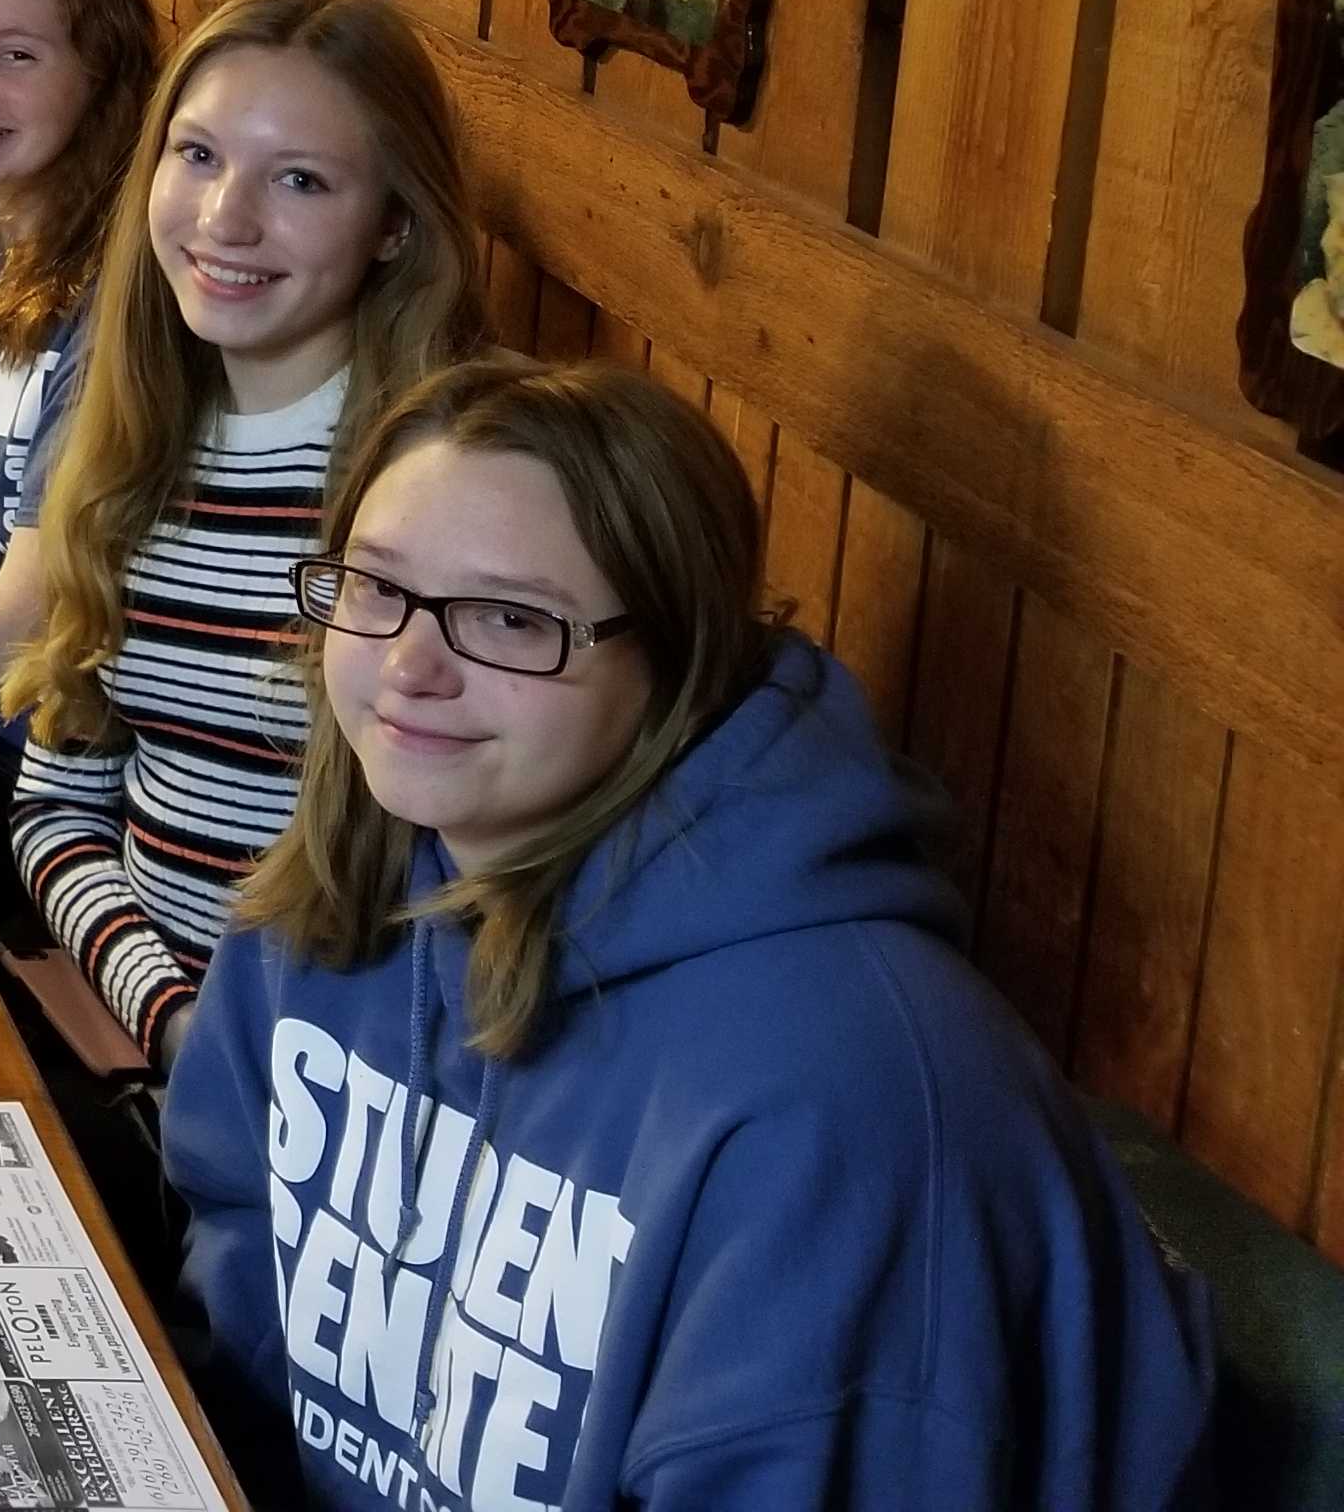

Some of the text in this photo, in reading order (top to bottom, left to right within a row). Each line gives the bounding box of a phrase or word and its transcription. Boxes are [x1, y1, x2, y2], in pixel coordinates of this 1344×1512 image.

[57, 1277, 85, 1316] Services
[74, 1317, 90, 1332] Tool
[75, 1273, 131, 1374] www.pelotoninc.com
[270, 1174, 564, 1512] ENTE
[84, 1335, 109, 1368] Machine
[37, 1384, 100, 1501] EXCELLENT
[64, 1407, 118, 1503] EXTERIORS
